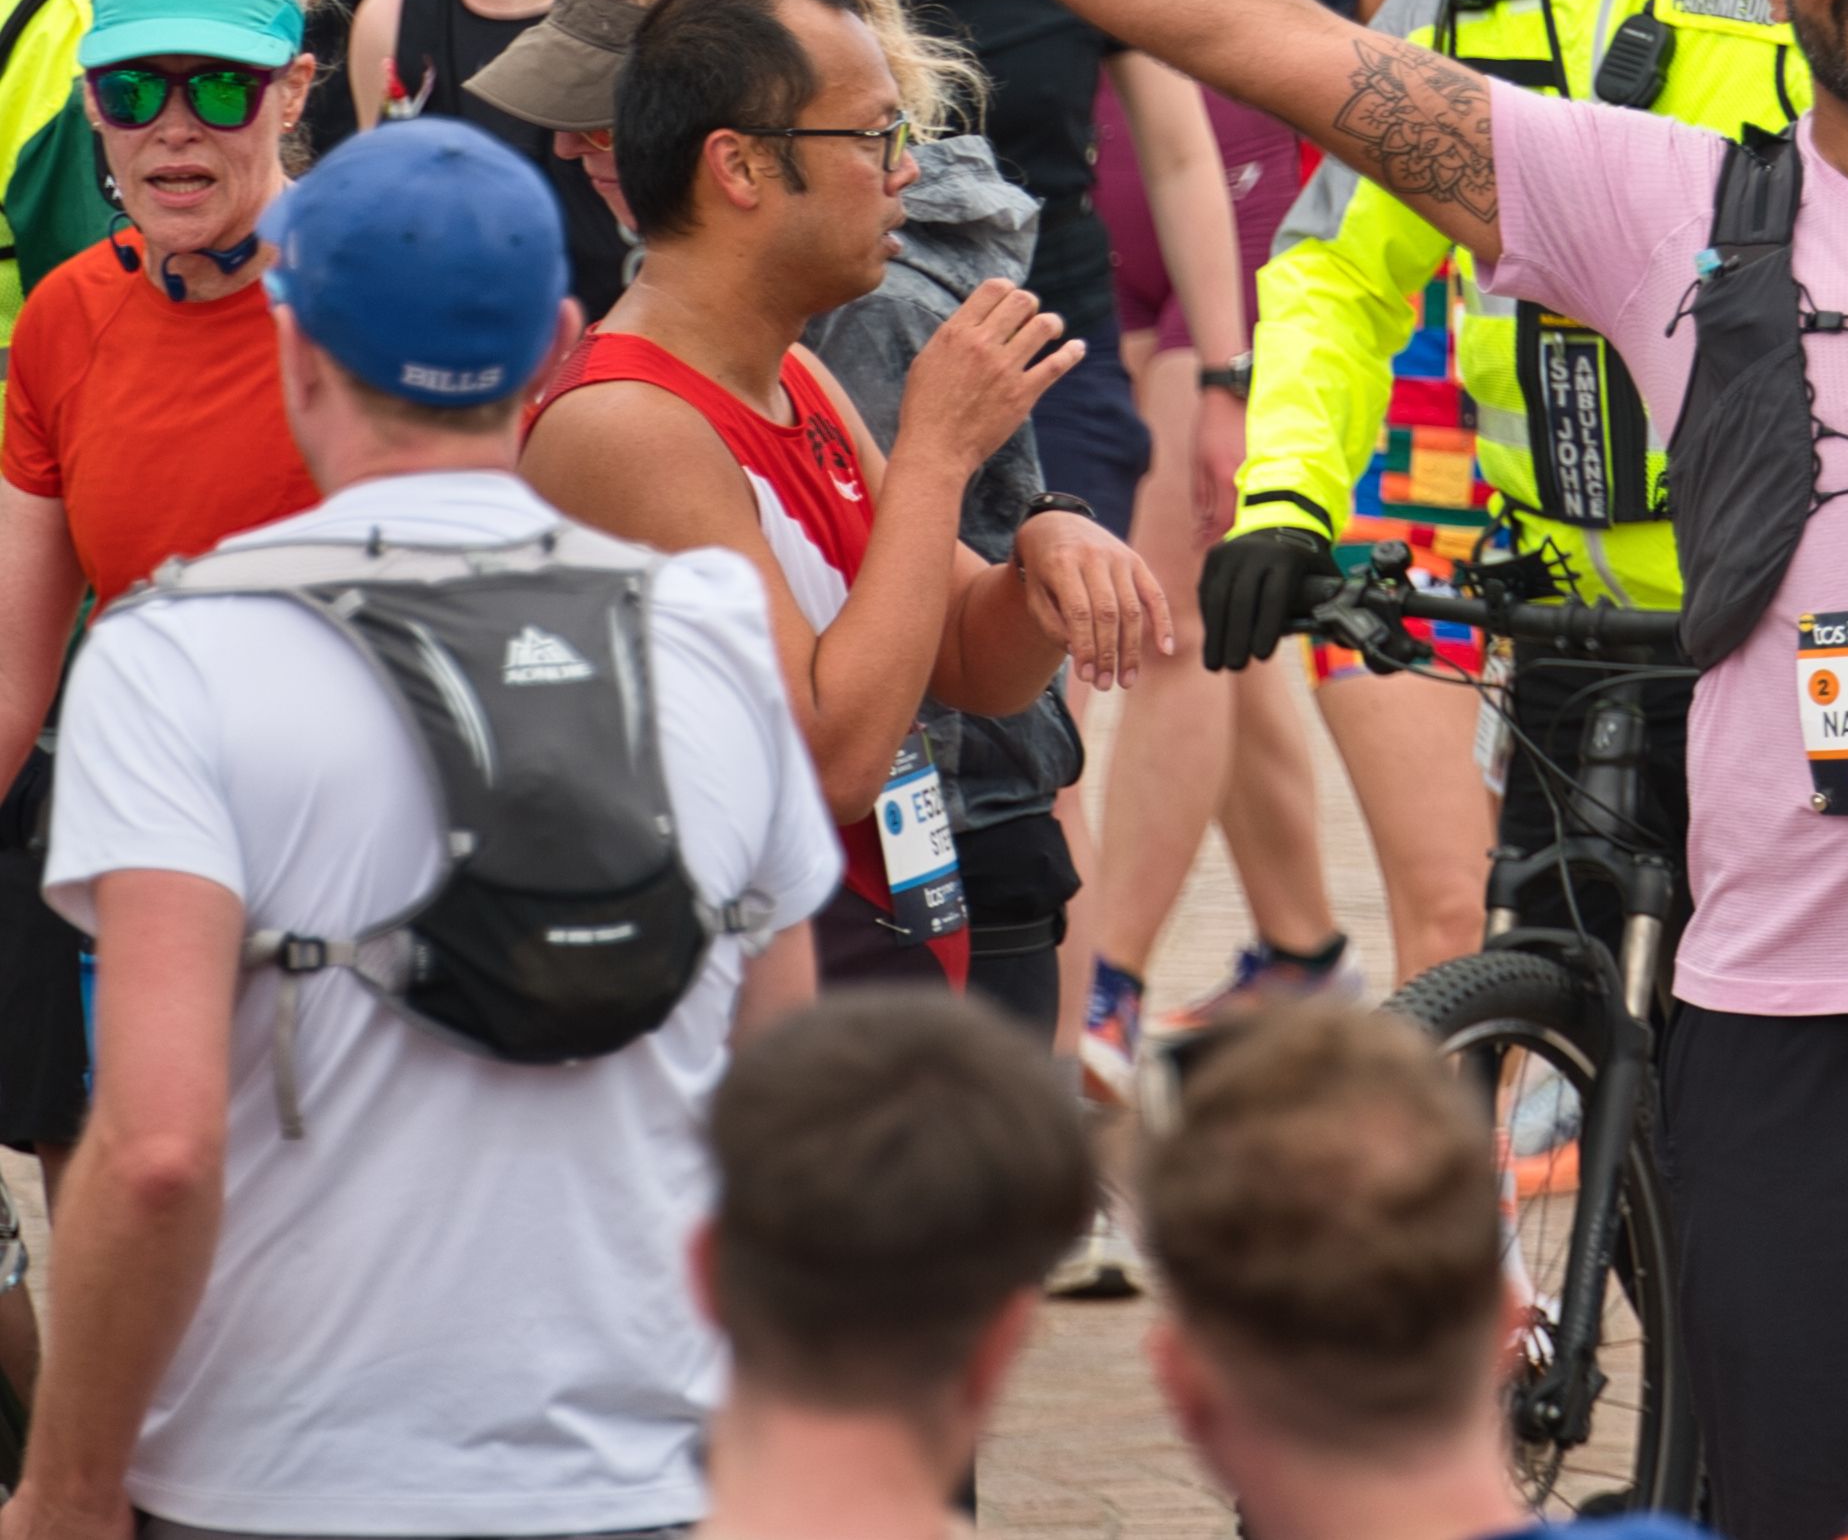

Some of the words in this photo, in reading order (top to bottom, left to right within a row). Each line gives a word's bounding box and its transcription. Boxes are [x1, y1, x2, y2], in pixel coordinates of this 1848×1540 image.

[400, 363, 504, 393] BILLS
[1551, 357, 1572, 408] ST
[1574, 355, 1606, 519] AMBULANCE
[1557, 417, 1586, 518] JOHN
[1813, 624, 1846, 645] tcs
[1817, 678, 1830, 697] 2
